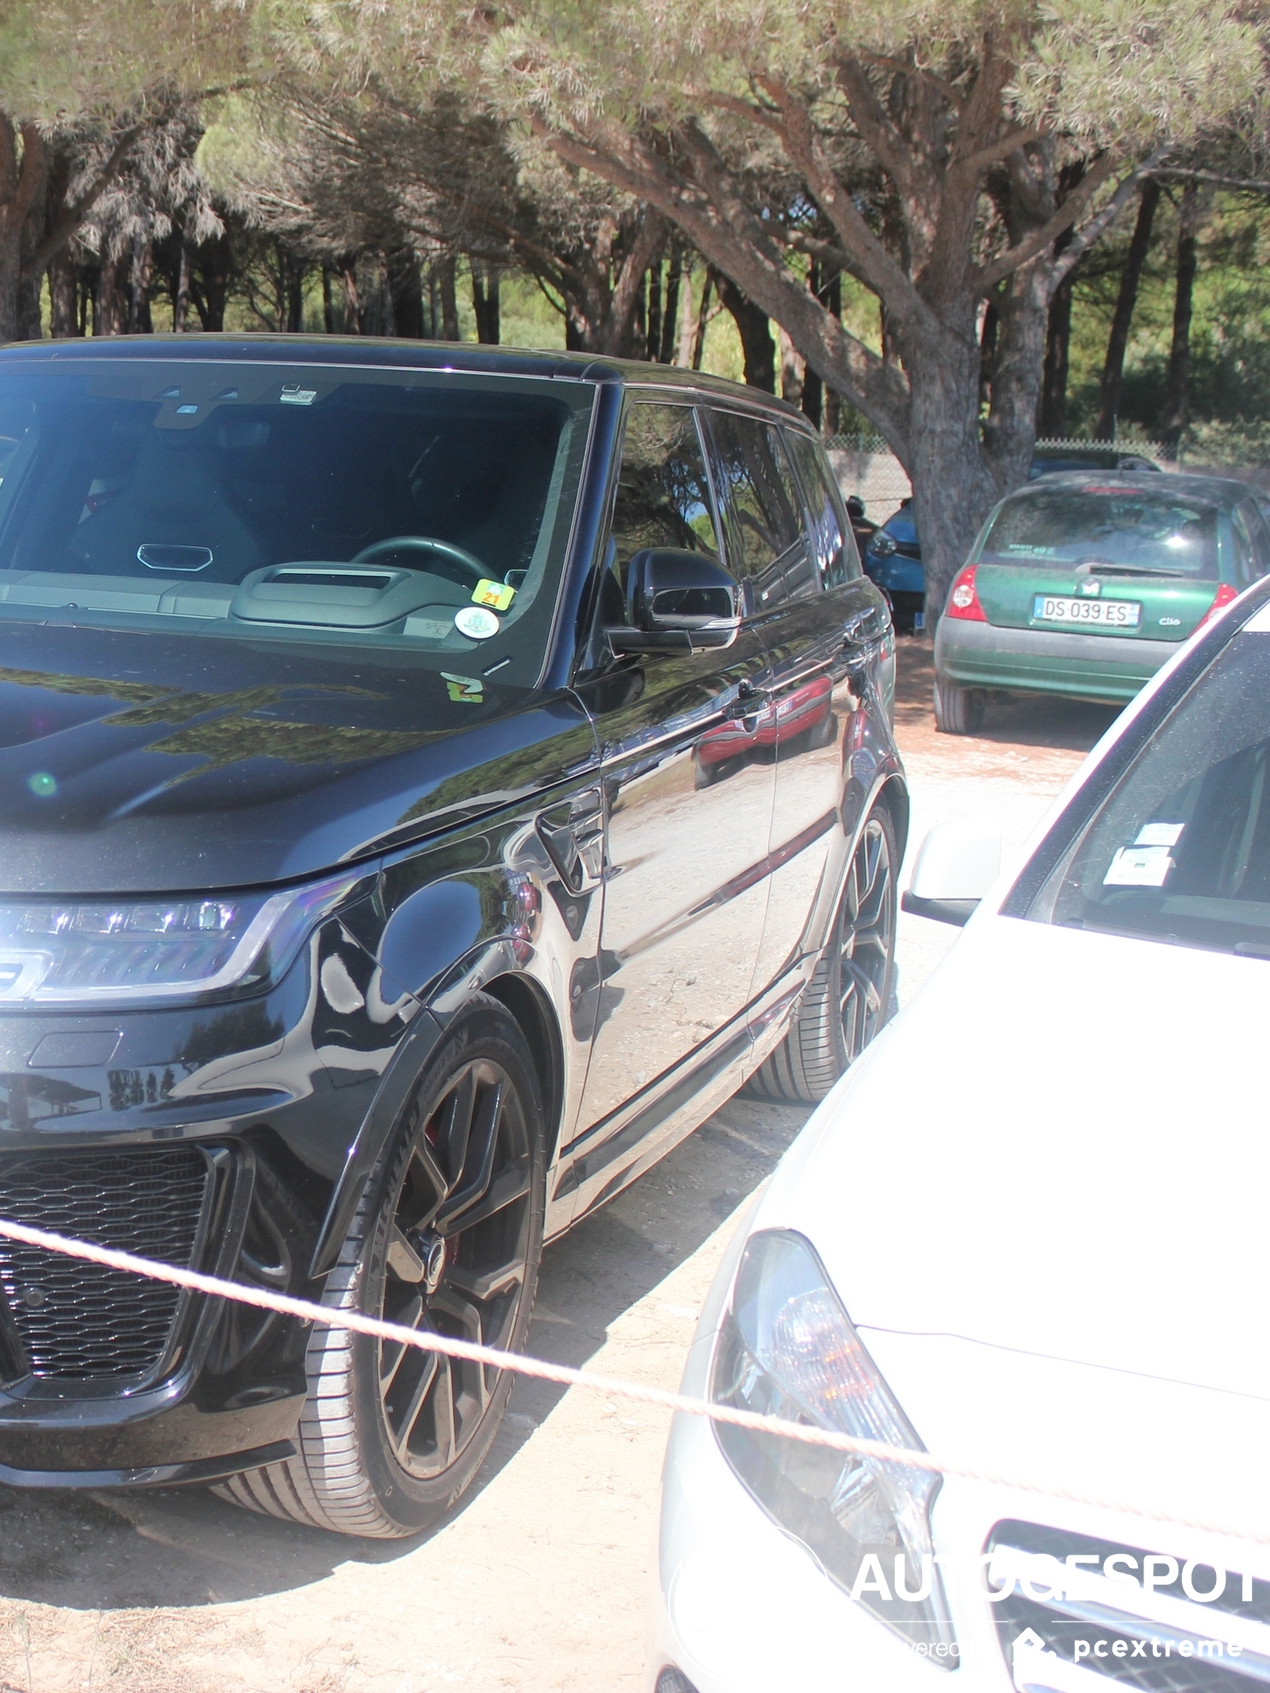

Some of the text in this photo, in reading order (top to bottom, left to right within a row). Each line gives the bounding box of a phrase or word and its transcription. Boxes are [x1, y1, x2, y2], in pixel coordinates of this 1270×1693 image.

[482, 592, 499, 604] 21
[1045, 600, 1127, 622] DS-039-ES
[373, 1107, 418, 1259] MICHELIN
